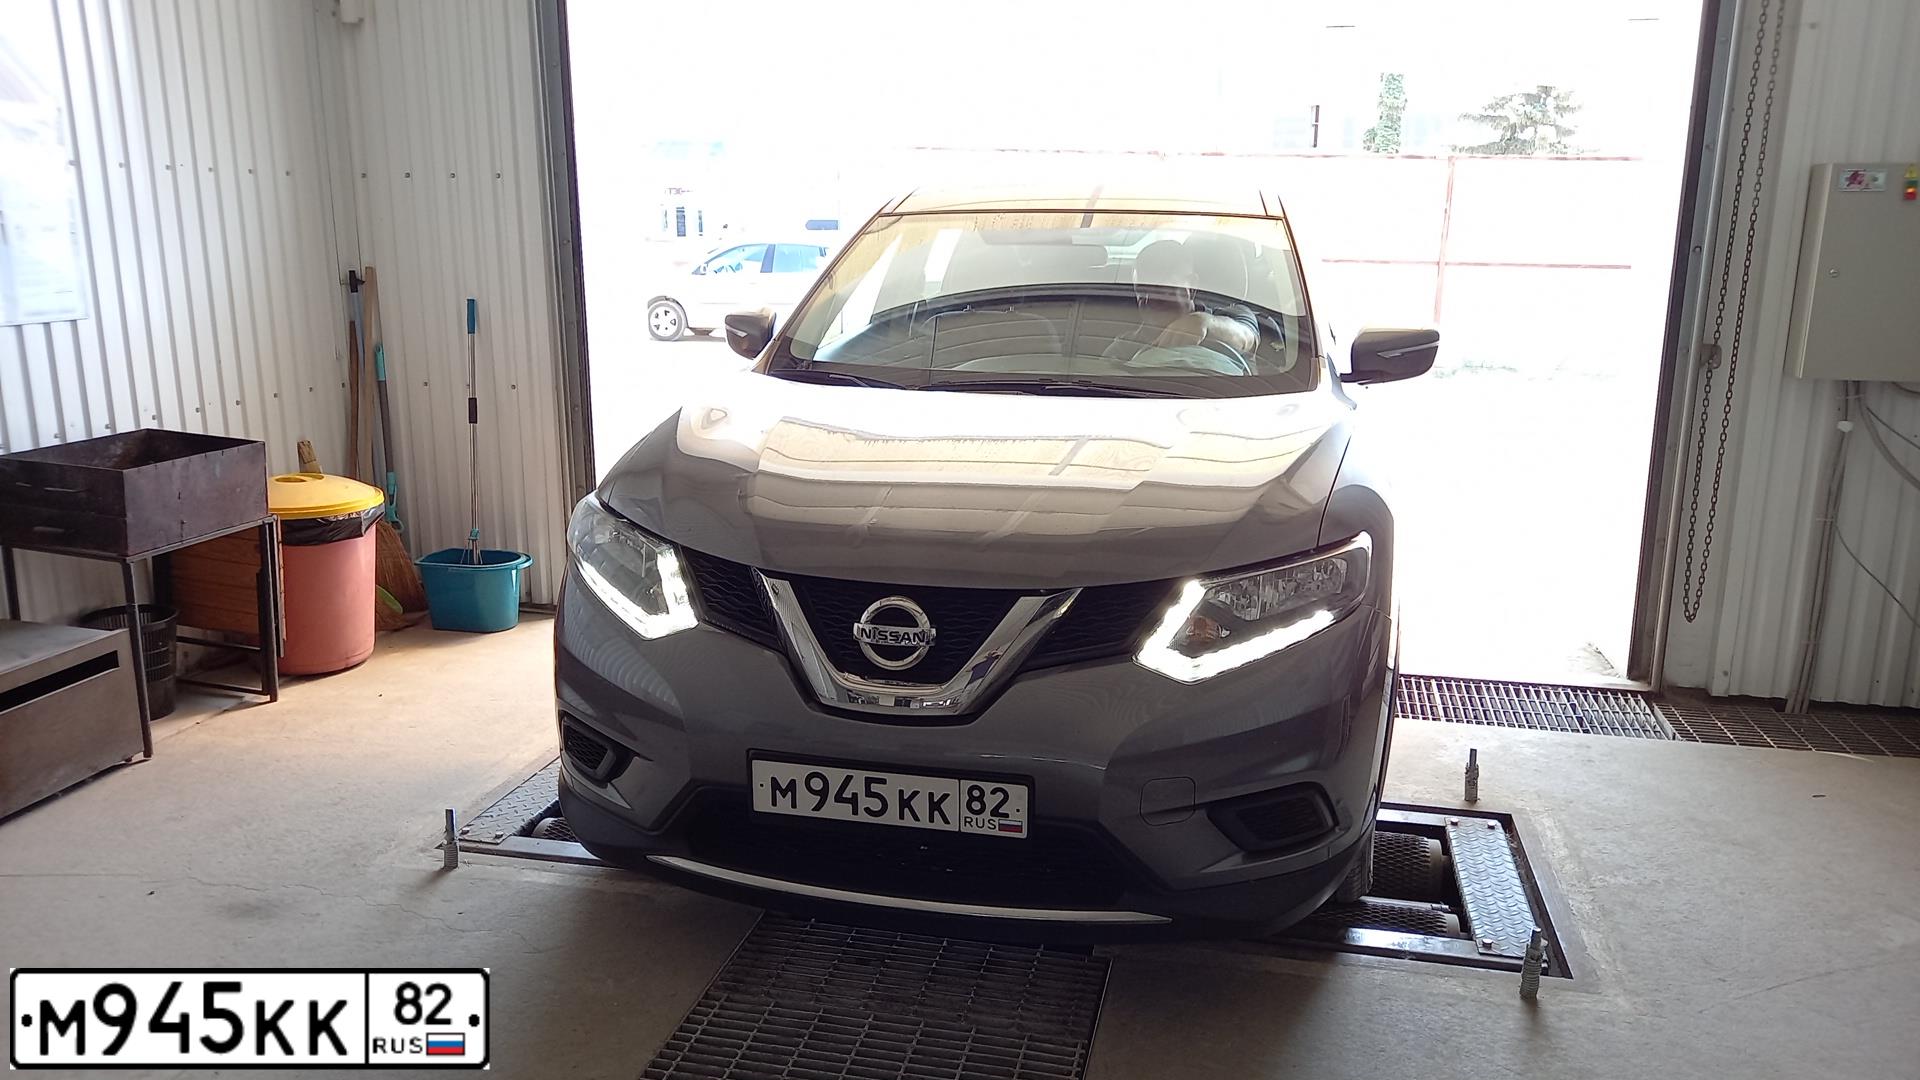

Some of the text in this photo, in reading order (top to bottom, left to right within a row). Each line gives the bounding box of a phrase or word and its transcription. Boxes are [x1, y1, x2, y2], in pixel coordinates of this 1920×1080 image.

[860, 627, 926, 643] NISSAN
[965, 784, 1010, 819] 82
[963, 816, 997, 831] RUS
